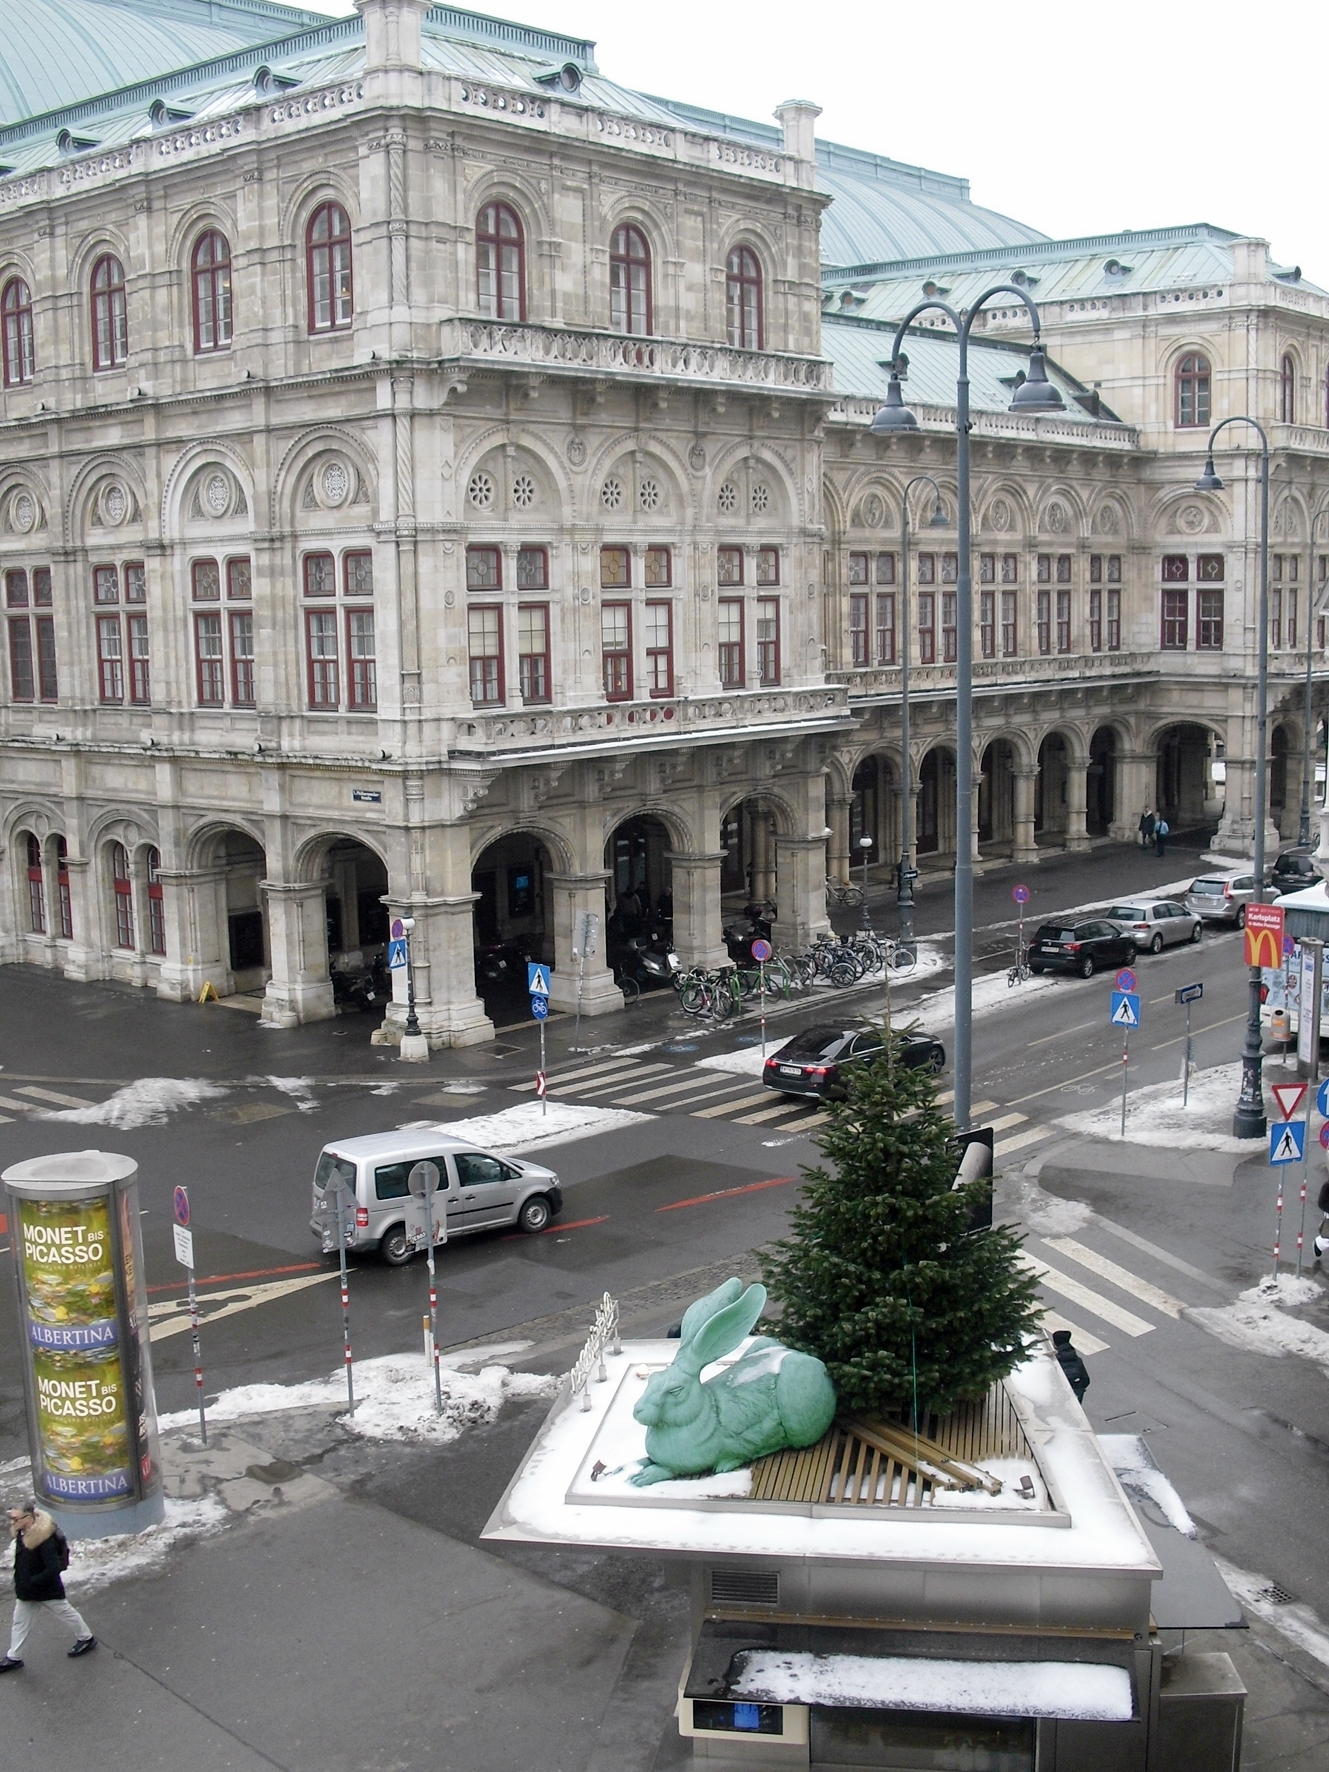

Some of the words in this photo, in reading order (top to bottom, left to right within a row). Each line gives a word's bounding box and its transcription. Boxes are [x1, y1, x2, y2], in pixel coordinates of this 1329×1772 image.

[1248, 914, 1281, 923] Karlsplatz
[23, 1222, 87, 1244] MONET
[87, 1231, 104, 1242] BIS
[25, 1242, 103, 1264] PICASSO
[32, 1325, 114, 1345] ALBERTINA
[37, 1375, 100, 1398] MONET
[101, 1383, 117, 1395] BIS
[39, 1394, 116, 1417] PICASSO
[46, 1474, 128, 1494] ALBERTINA
